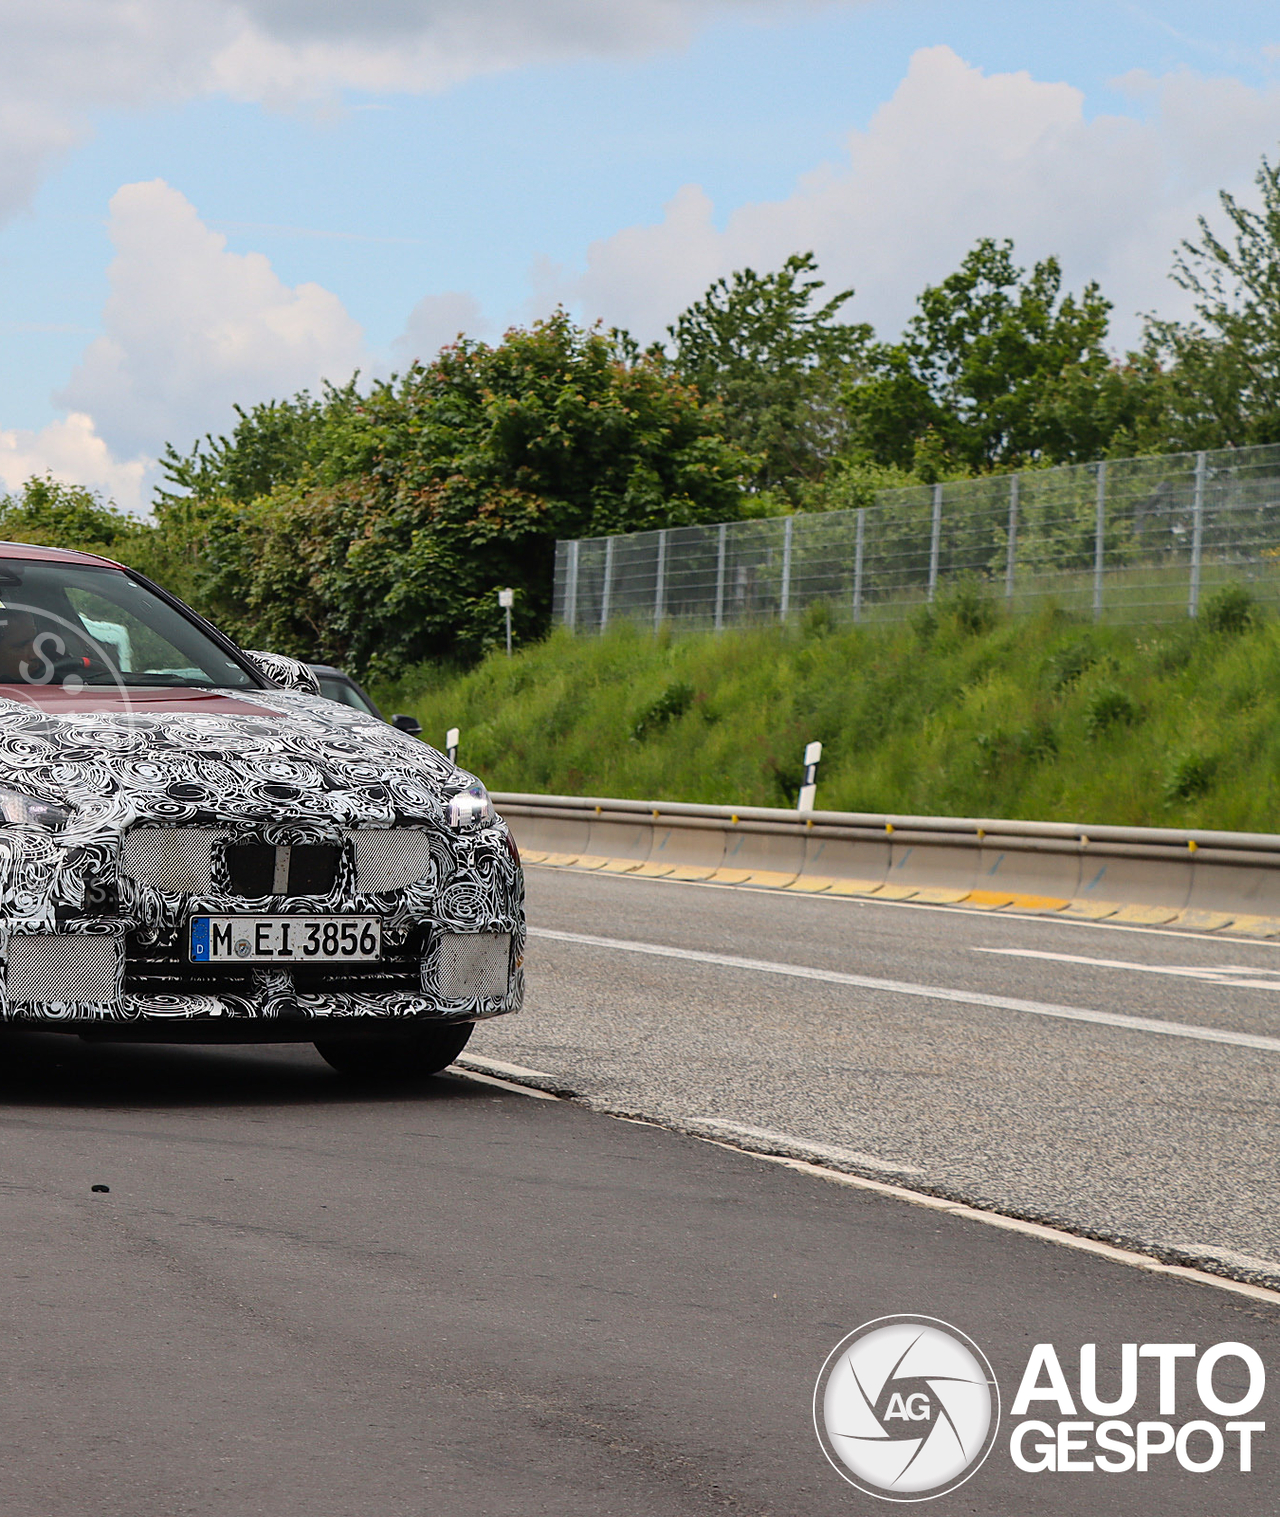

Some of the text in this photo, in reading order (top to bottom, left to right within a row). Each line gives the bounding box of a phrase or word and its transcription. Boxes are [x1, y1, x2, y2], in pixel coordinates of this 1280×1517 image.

[196, 922, 376, 956] D M EI 3856
